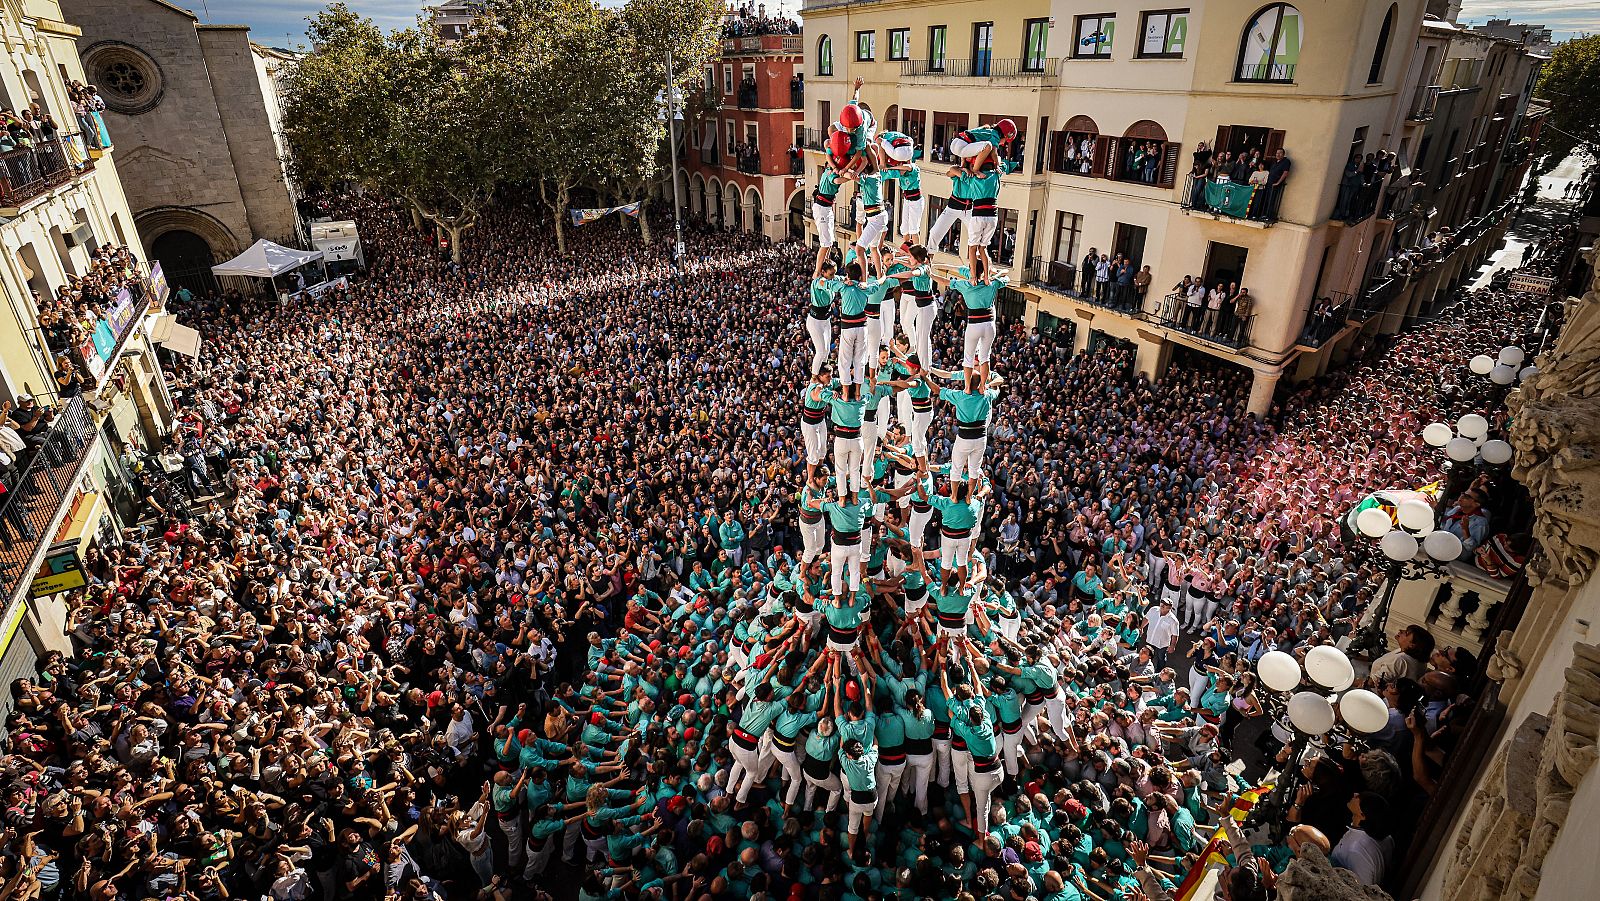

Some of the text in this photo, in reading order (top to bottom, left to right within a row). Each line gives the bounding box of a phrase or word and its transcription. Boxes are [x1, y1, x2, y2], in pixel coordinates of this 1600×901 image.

[860, 35, 869, 58] A
[892, 33, 902, 58] A
[1098, 22, 1115, 53] A
[1166, 17, 1187, 53] A
[1253, 15, 1299, 79] A
[1509, 283, 1548, 293] BERTRAN
